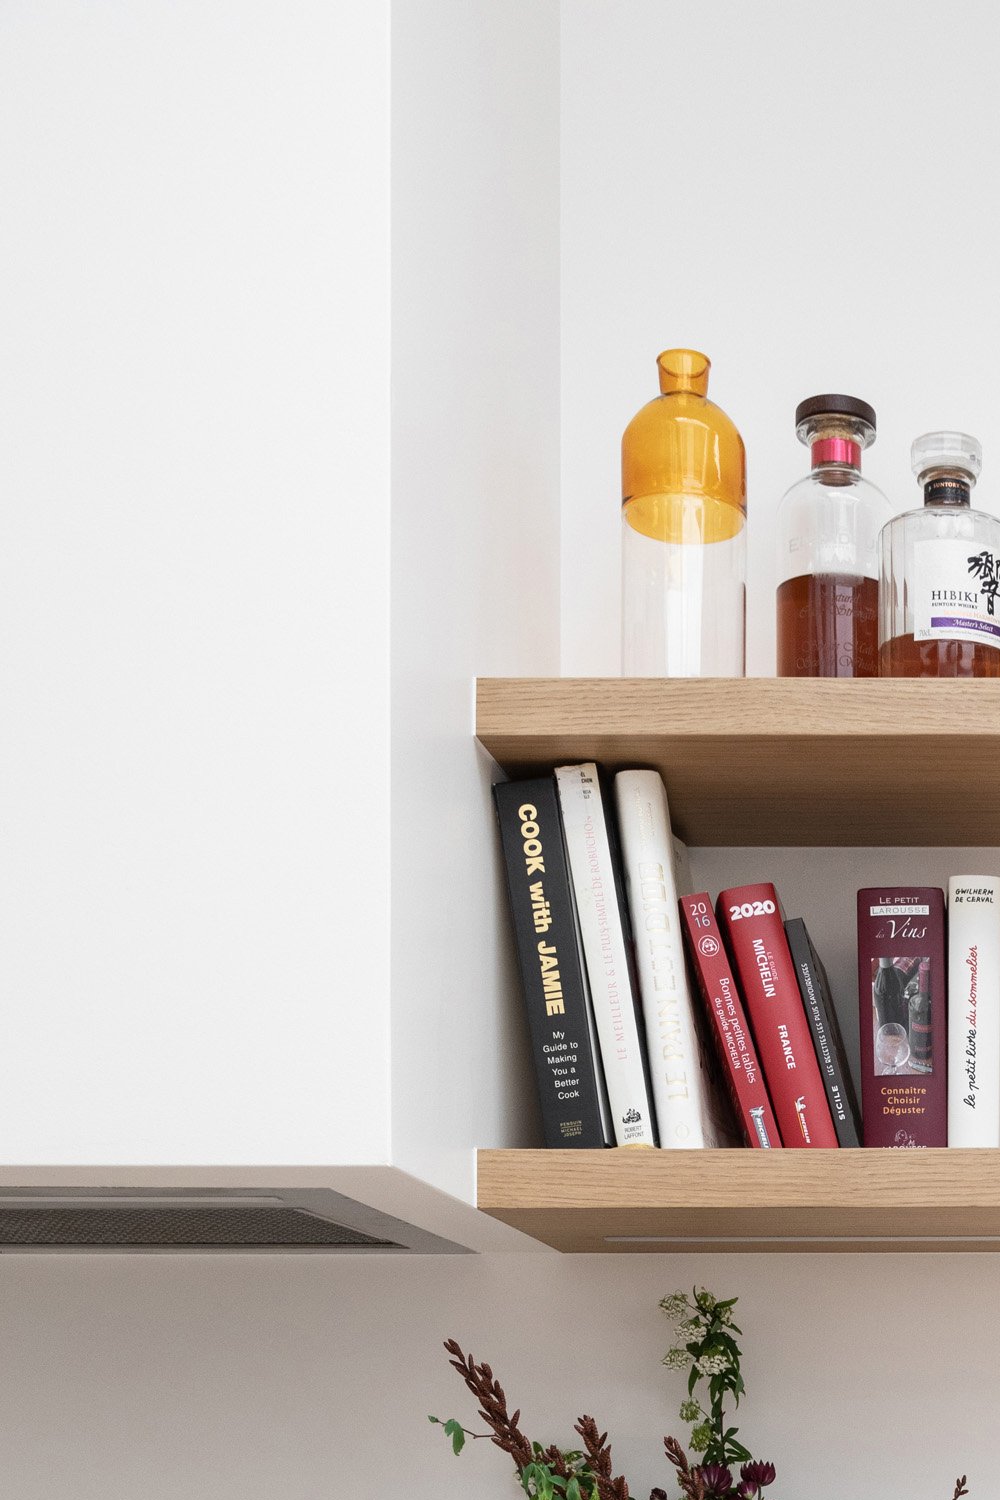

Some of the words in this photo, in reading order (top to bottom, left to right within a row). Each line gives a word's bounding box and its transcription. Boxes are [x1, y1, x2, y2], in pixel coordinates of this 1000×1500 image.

[931, 590, 978, 603] HIBIKI
[952, 619, 978, 629] Master's
[978, 622, 994, 632] Select
[518, 803, 546, 876] COOK
[592, 876, 603, 889] DE
[955, 888, 994, 896] GWILHERM
[529, 881, 553, 933] with
[879, 896, 892, 904] LE
[894, 896, 919, 904] PETIT
[690, 902, 707, 916] 20
[729, 899, 776, 921] 2020
[872, 906, 928, 915] LAROUSSE
[694, 915, 711, 928] 16
[886, 916, 927, 939] Vins
[603, 954, 614, 964] LE
[767, 951, 773, 960] LE
[752, 938, 776, 998] MICHELIN
[769, 961, 779, 981] GUIDE
[537, 940, 566, 1017] JAMIE
[965, 945, 978, 1007] sommelier
[801, 963, 817, 1005] SAVOUREUSES
[714, 997, 723, 1008] du
[607, 981, 624, 1041] MEILLEUR
[811, 1006, 821, 1021] PLUS
[965, 1009, 977, 1028] du
[716, 1009, 730, 1031] guide
[552, 1031, 565, 1040] My
[657, 999, 684, 1060] PAIN
[719, 978, 736, 1016] Bonnes
[728, 1018, 747, 1051] petites
[741, 1053, 757, 1084] tables
[815, 1022, 824, 1034] LES
[542, 1042, 568, 1053] Guide
[569, 1041, 579, 1049] to
[725, 1031, 742, 1069] MICHELIN
[777, 1024, 796, 1070] FRANCE
[819, 1034, 832, 1064] RECETTES
[965, 1028, 977, 1058] livre
[547, 1054, 577, 1065] Making
[617, 1047, 628, 1060] LE
[552, 1068, 568, 1076] You
[826, 1065, 835, 1076] LES
[963, 1058, 979, 1091] petit
[554, 1078, 580, 1088] Better
[665, 1071, 689, 1100] LE
[557, 1090, 580, 1100] Cook
[831, 1085, 846, 1120] SICILE
[887, 1096, 920, 1104] Choisir
[963, 1094, 976, 1109] le
[883, 1106, 926, 1116] Déguster
[624, 1125, 642, 1133] ROBERT
[624, 1131, 644, 1140] LAFFONT
[755, 1117, 769, 1148] MICHELI
[800, 1112, 811, 1144] MICHELIN
